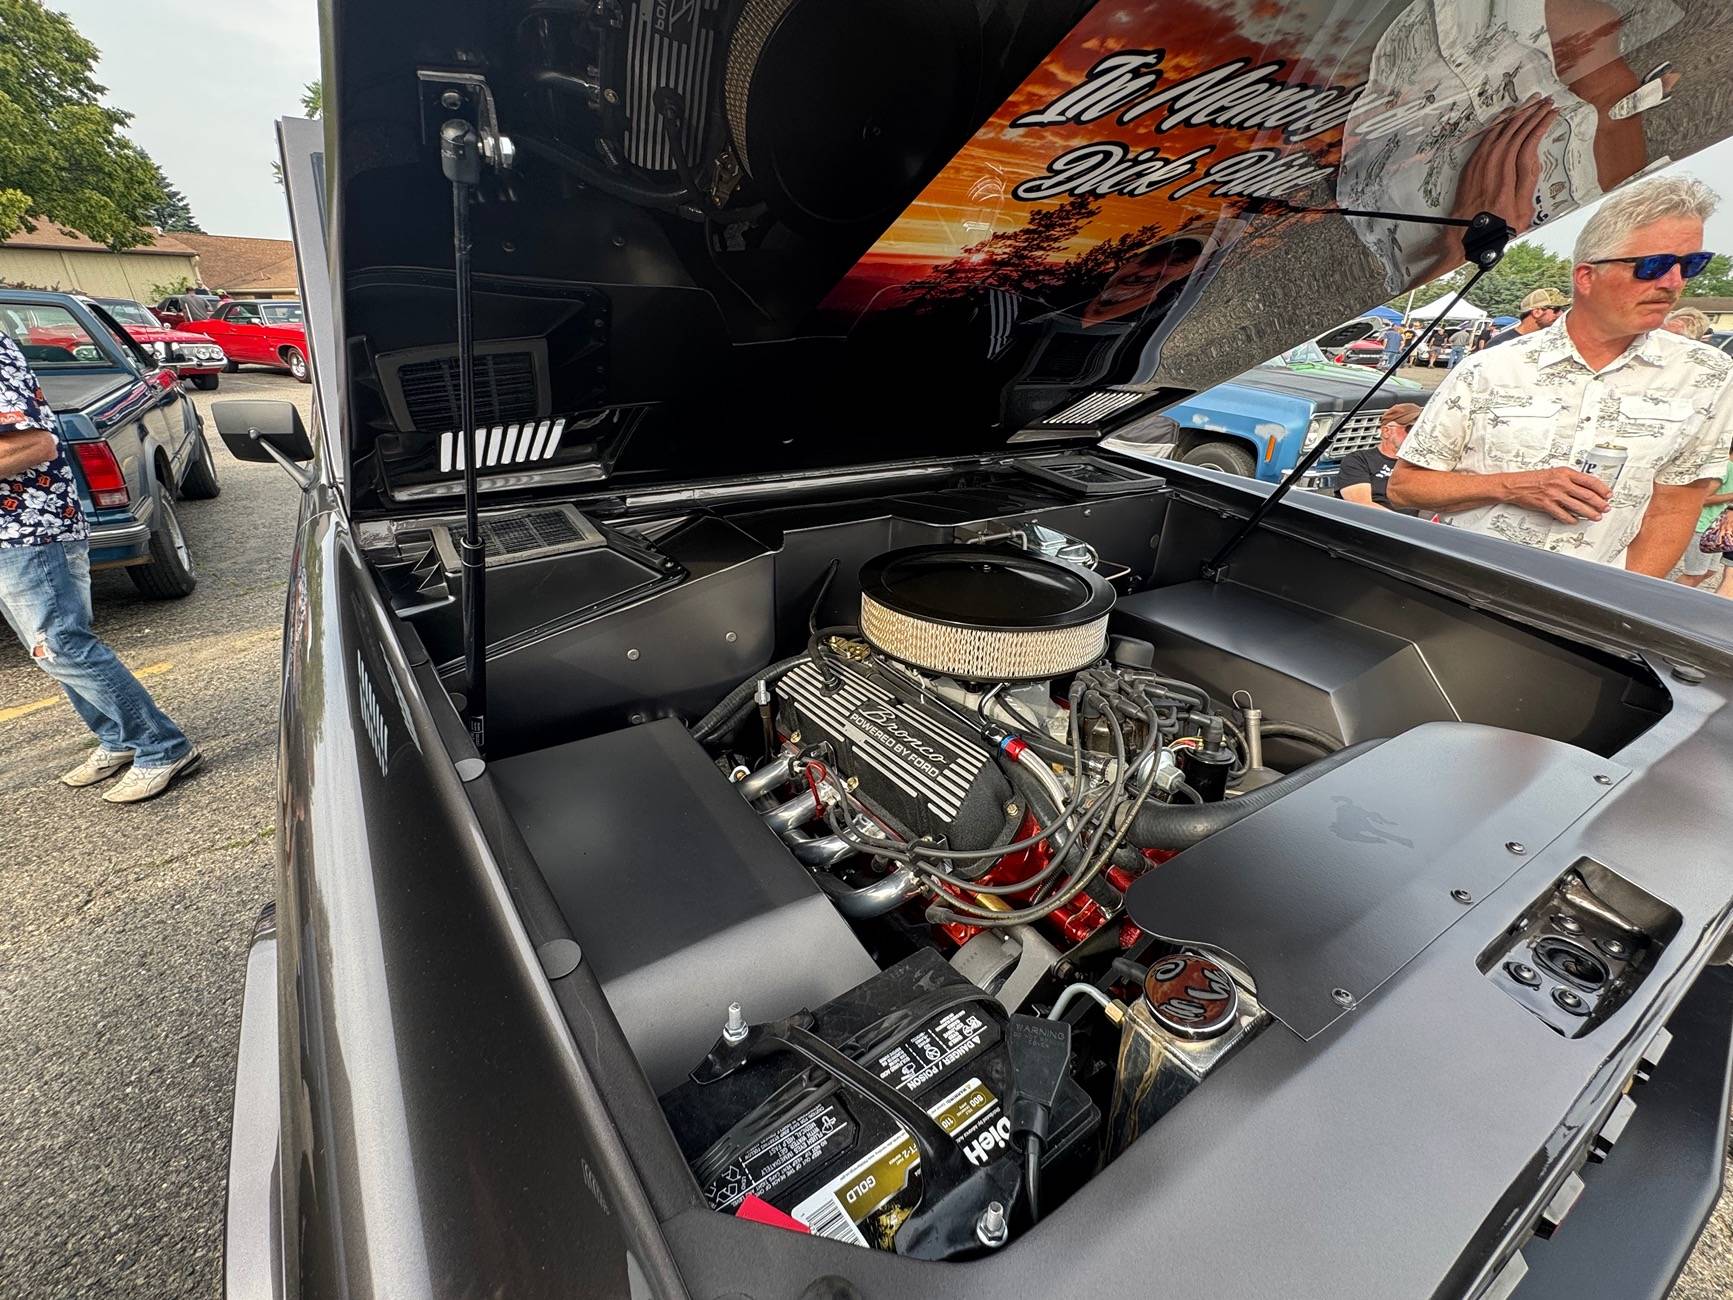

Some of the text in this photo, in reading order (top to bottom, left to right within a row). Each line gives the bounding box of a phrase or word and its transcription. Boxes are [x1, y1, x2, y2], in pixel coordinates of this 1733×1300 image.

[1012, 50, 1164, 127] In
[1118, 58, 1394, 143] Memory
[1014, 141, 1214, 200] Dick
[849, 713, 940, 778] POWERED BY FORD
[858, 705, 947, 764] Bronco
[1015, 1023, 1065, 1041] WARNING
[941, 1038, 975, 1067] DANGER
[906, 1064, 938, 1091] POISON
[766, 1120, 817, 1156] MEDICAL HELP FAST
[805, 1125, 820, 1138] WITH
[758, 1131, 823, 1176] FLUSH EYES IMMEDIATELY
[775, 1146, 789, 1158] GET
[800, 1156, 812, 1166] OUT
[810, 1149, 822, 1160] KEEP
[843, 1173, 877, 1204] GOLD
